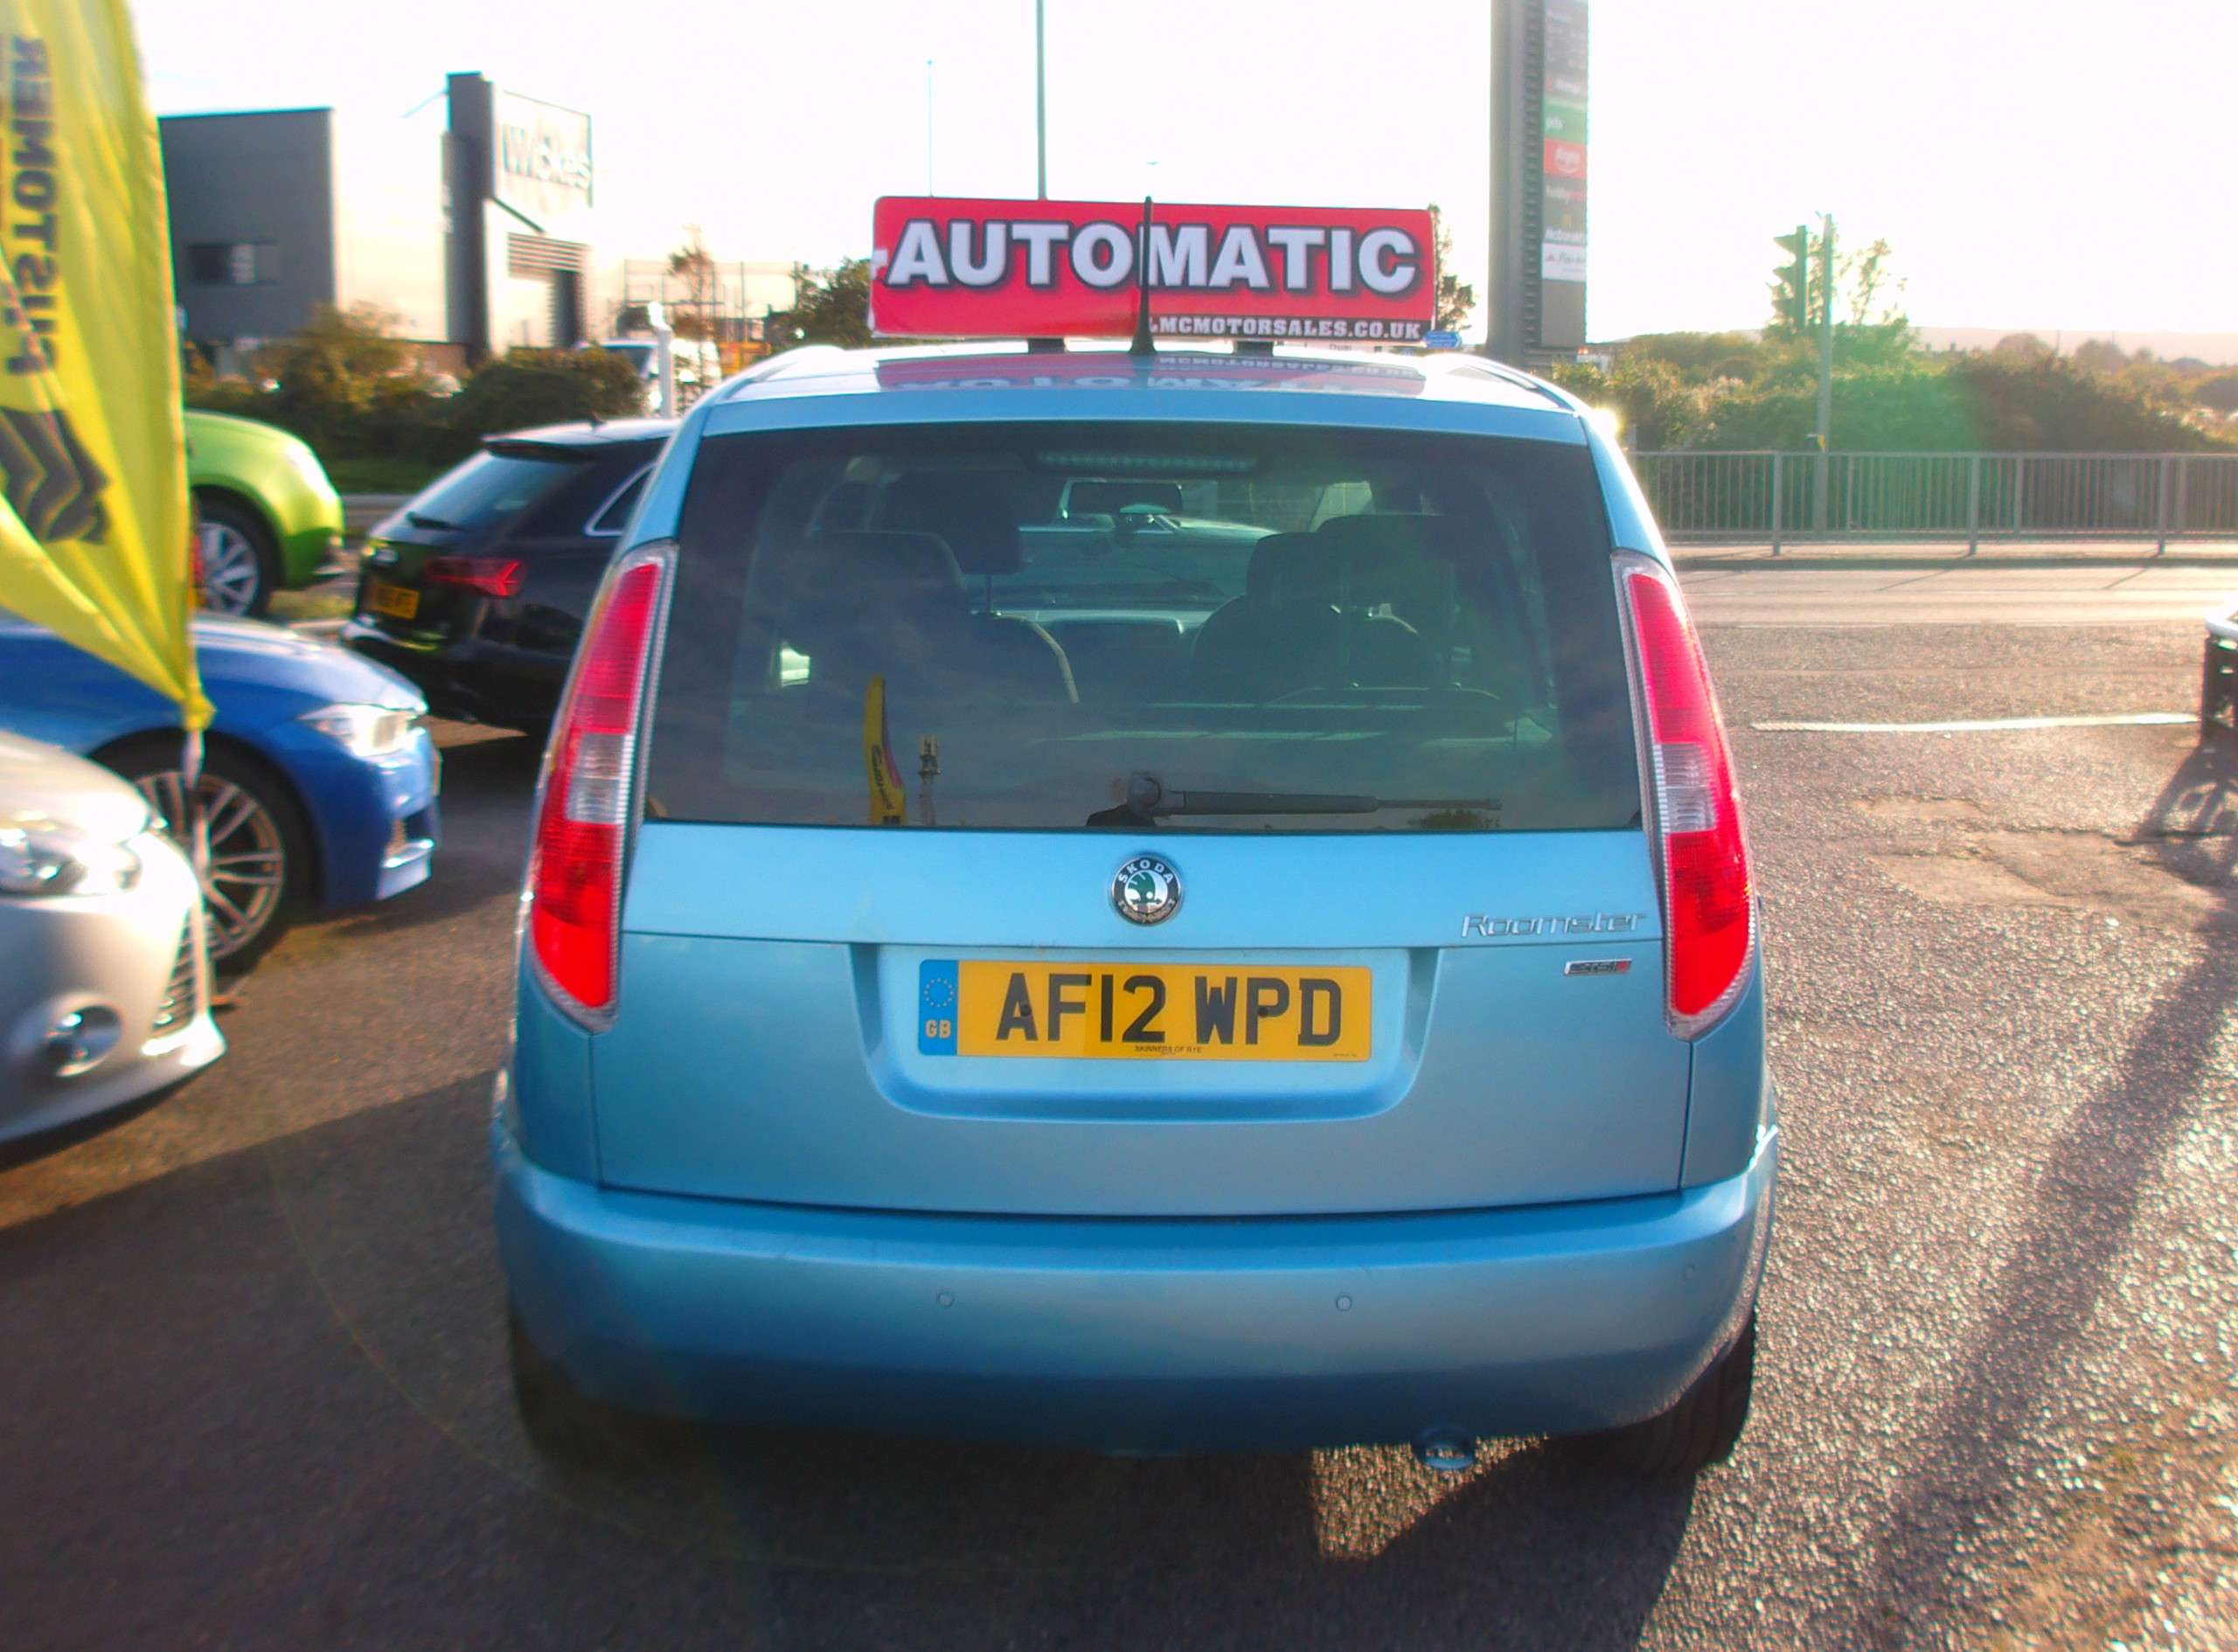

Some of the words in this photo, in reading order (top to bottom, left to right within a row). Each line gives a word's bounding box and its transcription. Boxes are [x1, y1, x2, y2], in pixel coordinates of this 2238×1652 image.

[887, 221, 1417, 293] AUTOMATIC
[1460, 913, 1647, 938] Roomster
[925, 1019, 951, 1038] GB
[995, 972, 1167, 1044] AF12
[1193, 975, 1343, 1046] WPD
